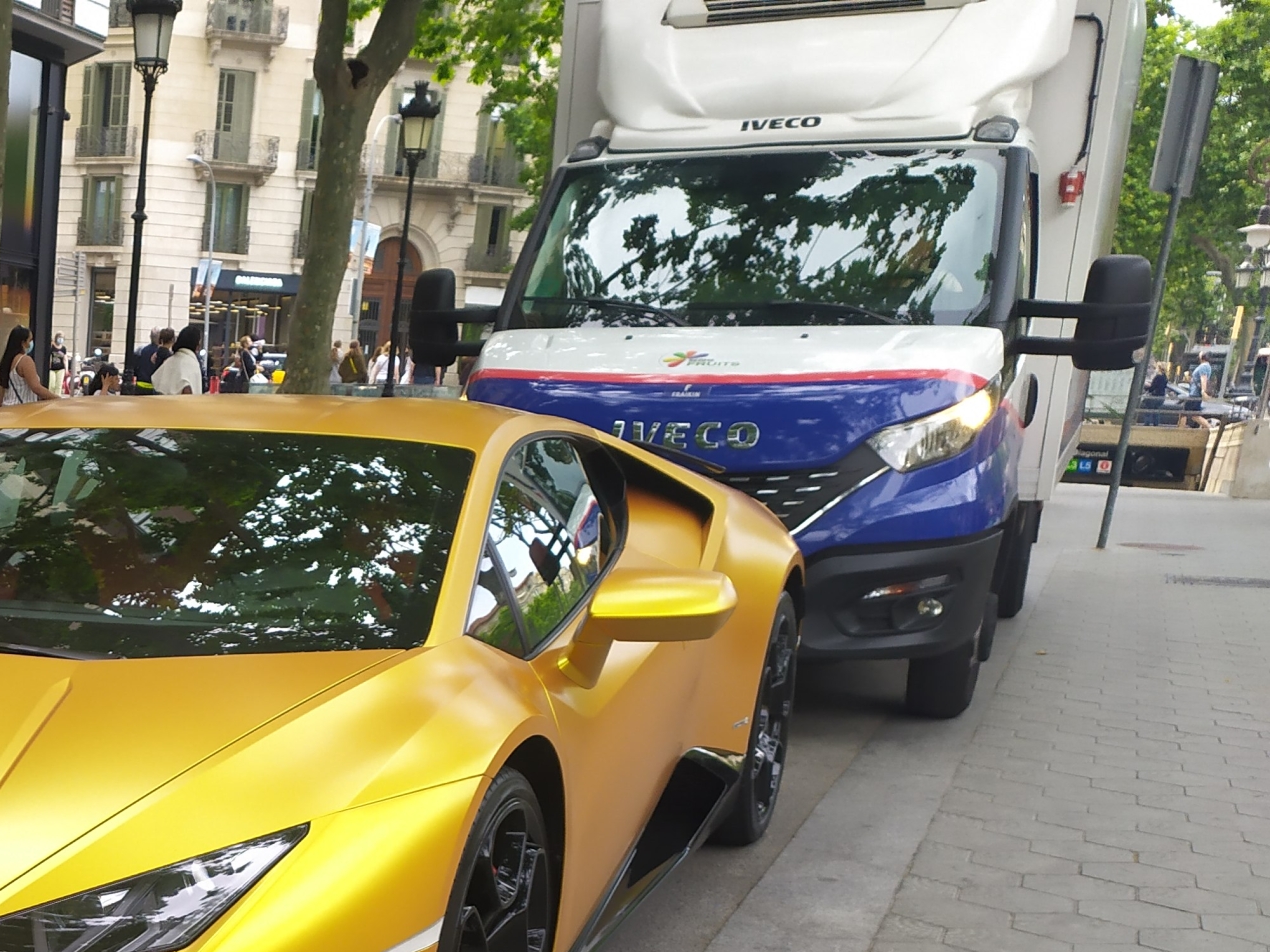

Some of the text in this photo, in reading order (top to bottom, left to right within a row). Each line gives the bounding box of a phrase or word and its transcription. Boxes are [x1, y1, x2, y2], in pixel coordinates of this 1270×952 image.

[740, 116, 822, 132] IVECO
[612, 420, 760, 449] IVECO
[1079, 461, 1092, 470] L5
